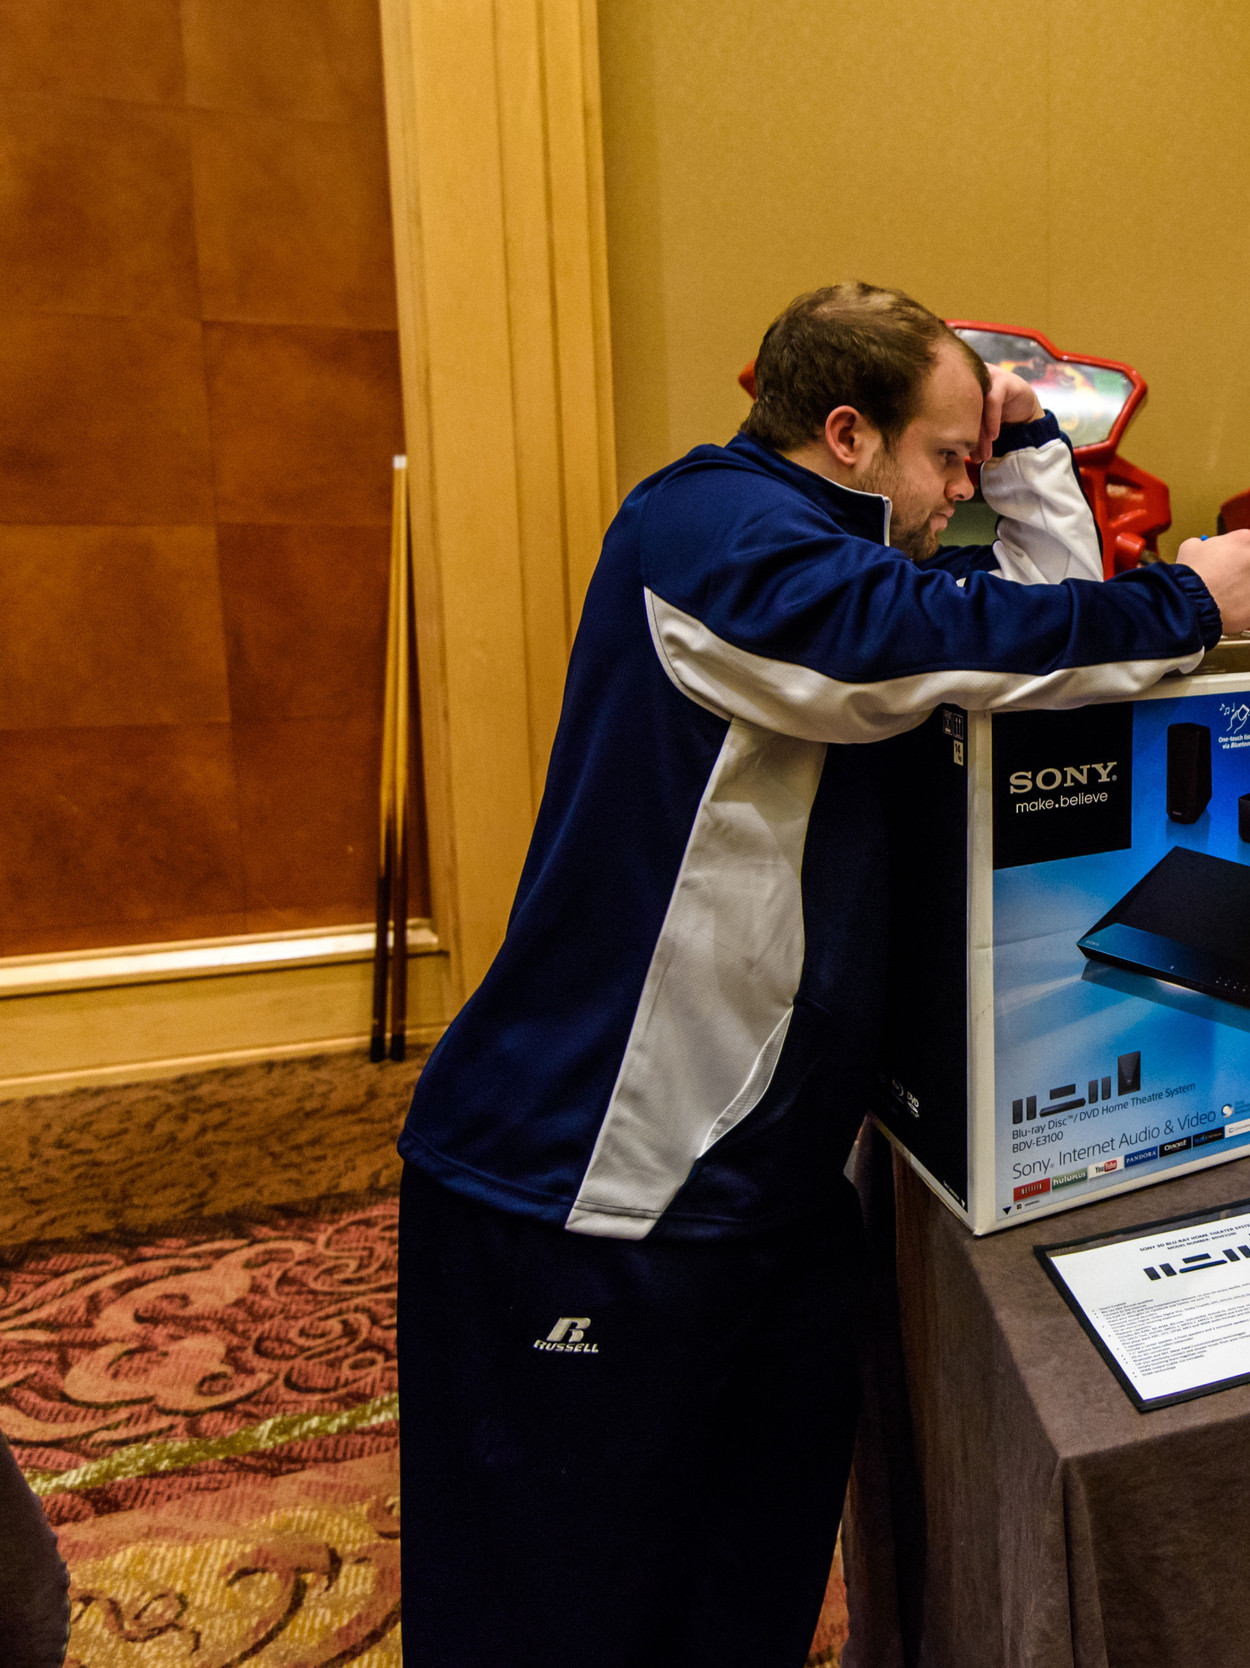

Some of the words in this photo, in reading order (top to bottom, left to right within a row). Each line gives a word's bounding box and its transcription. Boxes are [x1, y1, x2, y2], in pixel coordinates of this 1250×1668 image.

[1009, 761, 1117, 795] SONY
[1016, 791, 1109, 814] make.believe
[1012, 1125, 1046, 1141] Blu-ray
[1079, 1108, 1100, 1122] DVD
[1101, 1101, 1129, 1116] Home
[1131, 1092, 1164, 1108] Theatre
[1165, 1083, 1197, 1100] System
[1012, 1131, 1064, 1153] BDV-E3100
[1012, 1157, 1051, 1180] Sony
[1059, 1137, 1116, 1167] Internet
[1118, 1125, 1160, 1150] Audio
[1163, 1119, 1175, 1136] &
[1177, 1110, 1217, 1131] Video
[1094, 1159, 1118, 1174] YouTube
[1125, 1149, 1157, 1164] PANDORA
[533, 1339, 599, 1354] RUSSELL
